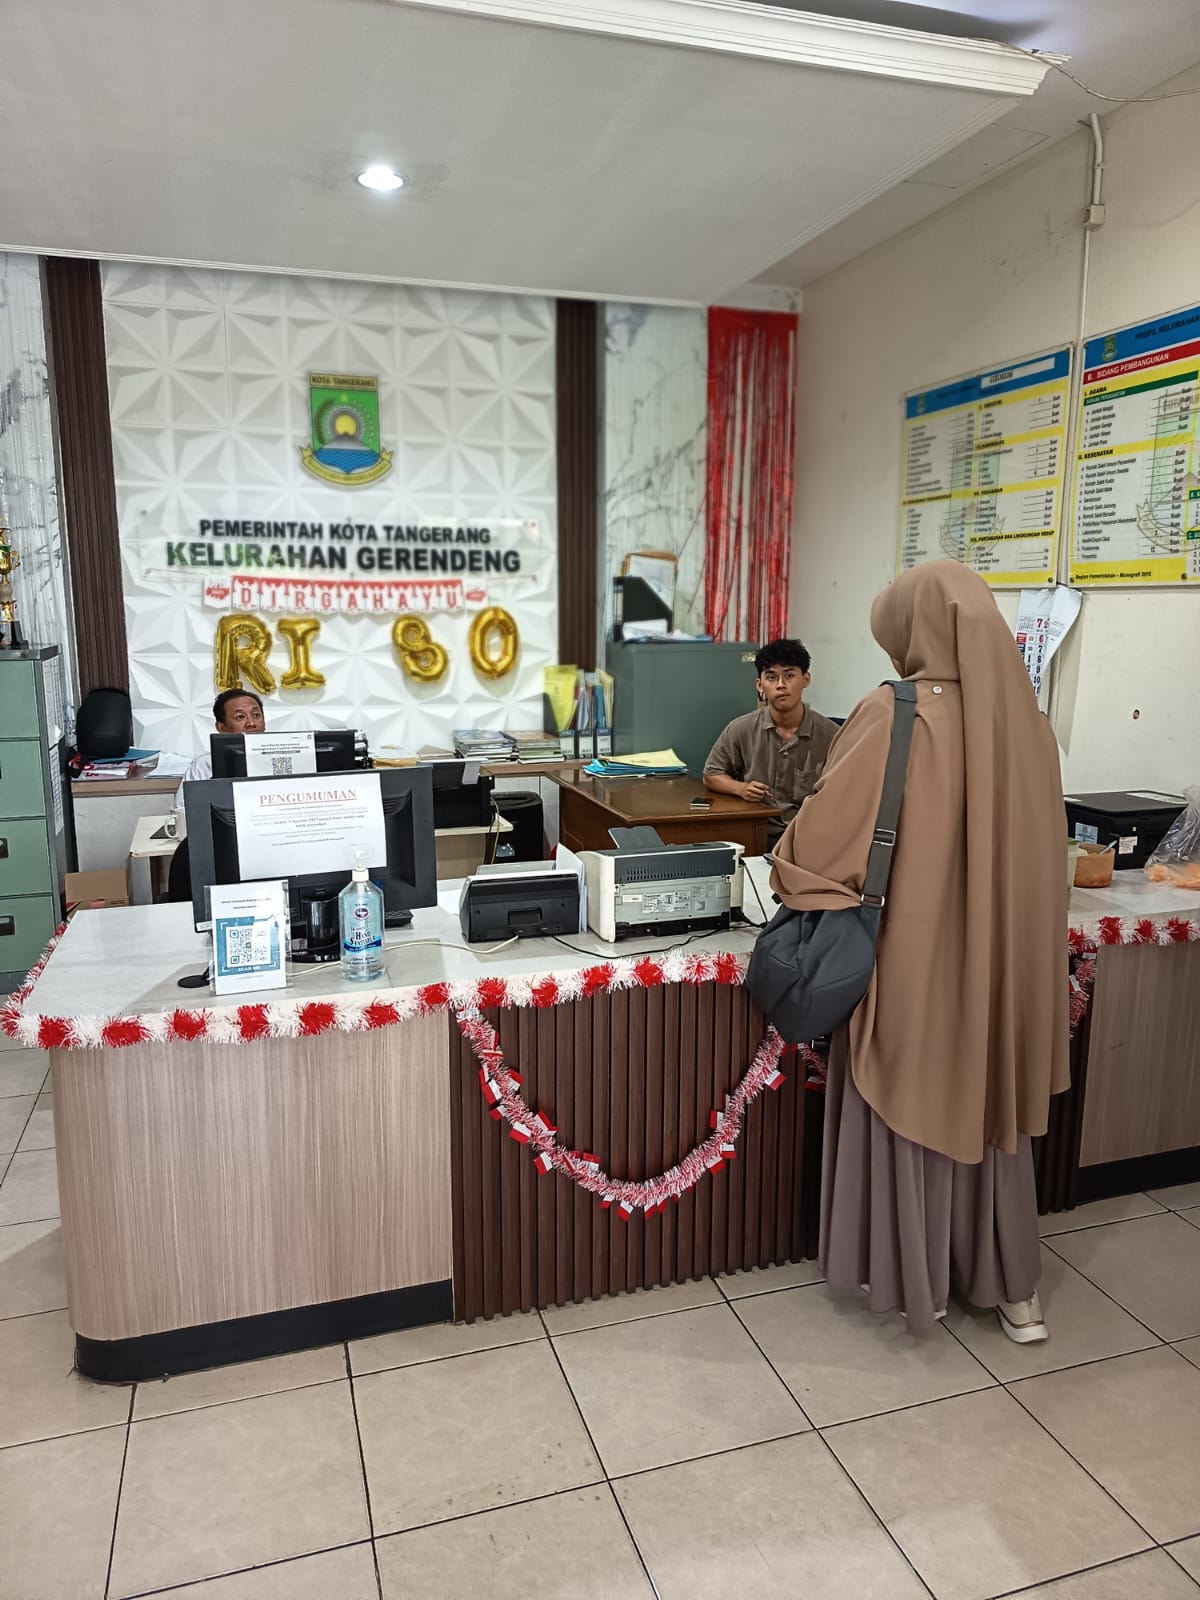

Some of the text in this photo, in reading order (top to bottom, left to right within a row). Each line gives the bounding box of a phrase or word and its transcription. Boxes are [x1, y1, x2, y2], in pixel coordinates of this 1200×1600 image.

[1096, 366, 1120, 378] BIDANG
[1120, 352, 1169, 372] PEMBANGUNAN
[312, 376, 376, 386] KOTA TANGERANG
[1089, 386, 1106, 395] AGAMA
[200, 520, 491, 544] PEMERINTAH KOTA TANGERANG
[166, 542, 520, 572] KELURAHAN GERENDENG
[241, 588, 457, 608] DIRGAHAYU
[215, 606, 518, 694] RI 80
[1034, 676, 1040, 684] 10
[259, 789, 357, 805] PENGUMUMAN
[356, 931, 371, 940] HAND
